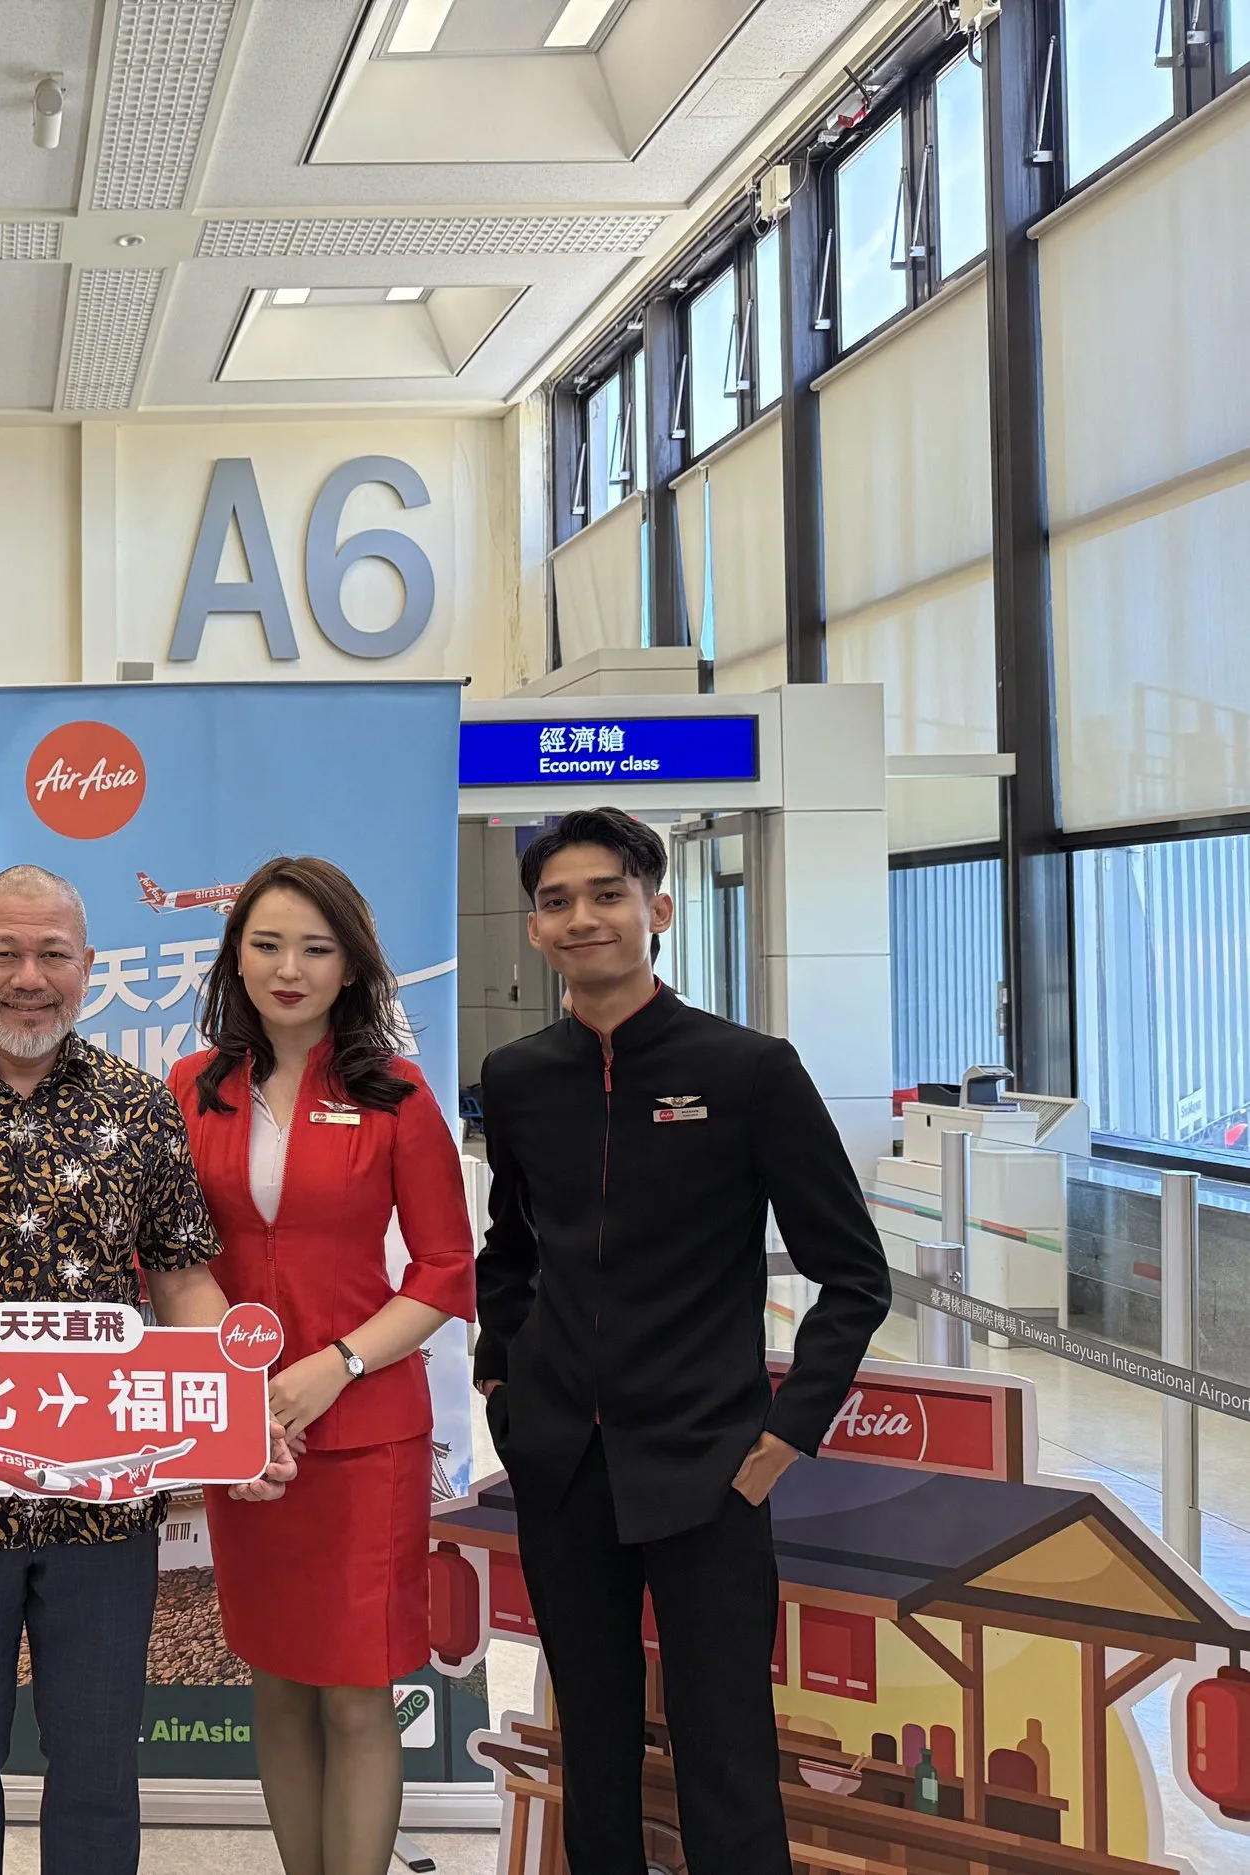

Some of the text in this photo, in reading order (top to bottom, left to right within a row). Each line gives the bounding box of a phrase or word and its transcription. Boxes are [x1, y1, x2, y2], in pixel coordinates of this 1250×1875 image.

[167, 455, 436, 661] A6
[539, 725, 626, 753] 經濟艙
[539, 755, 660, 776] Economy class
[195, 884, 246, 899] airasia.c
[0, 1309, 125, 1342] 天天直飛
[930, 1287, 1017, 1336] 臺灣桃園國際機場
[1019, 1319, 1057, 1347] Taiwan
[1059, 1333, 1109, 1366] Taoyuan
[1112, 1352, 1196, 1395] International
[108, 1367, 229, 1433] 福岡
[150, 1717, 250, 1742] AirAsia
